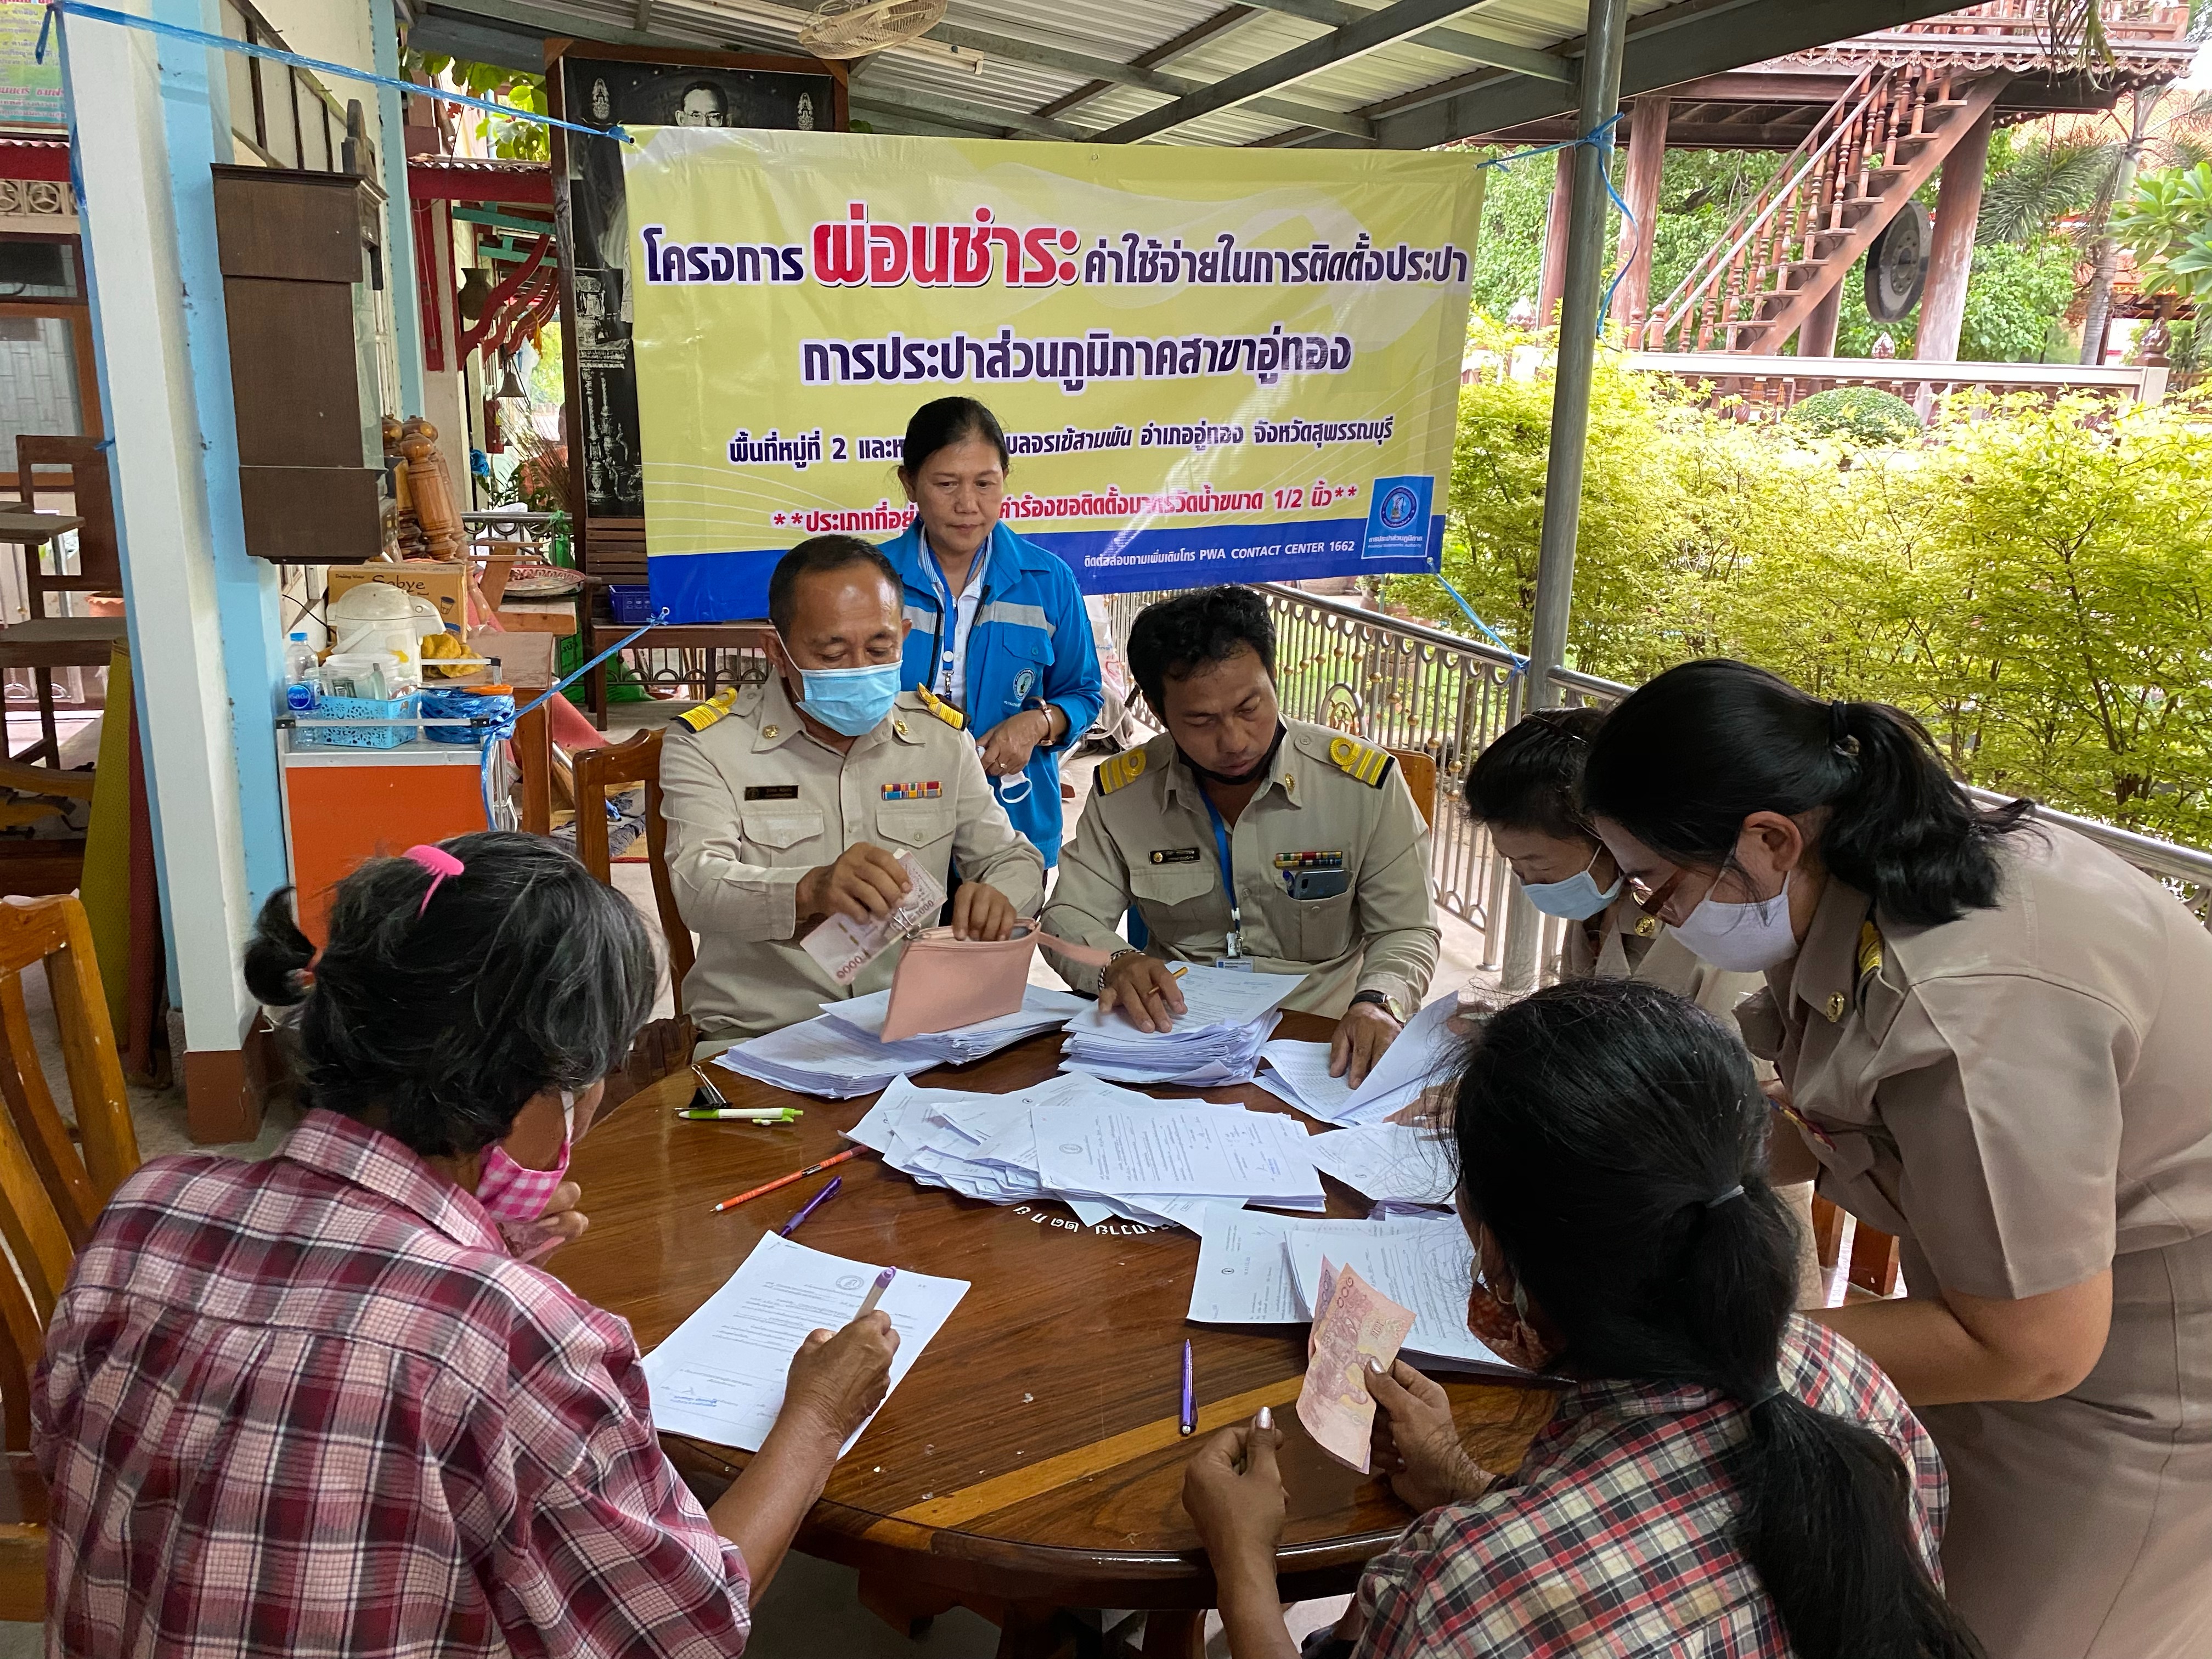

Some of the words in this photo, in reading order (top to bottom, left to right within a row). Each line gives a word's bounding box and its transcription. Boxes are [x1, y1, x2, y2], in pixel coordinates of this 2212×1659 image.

[643, 228, 804, 282] โครงการ
[814, 203, 1079, 285] ผ่อนชำระ
[1085, 233, 1468, 283] ค่าใช้จ่ายในการติดตั้งประปา
[804, 326, 1352, 392] การประปาส่วนภูมิภาคสาขาอู่ทอง
[730, 430, 821, 469] พื้นที่หมู่ที่
[832, 437, 847, 460] 2
[859, 439, 905, 459] และห
[1006, 425, 1132, 454] บลจรเข้สามพัน
[1141, 421, 1244, 451] อำเภออู่ทอง
[1254, 415, 1393, 448] จังหวัดสุพรรณบุรี
[1274, 488, 1304, 509] 1/2
[1199, 548, 1226, 560] PWA
[1231, 544, 1280, 559] CONTACT
[1284, 541, 1325, 555] CENTER
[1329, 540, 1355, 552] 1662
[916, 900, 934, 917] 1000
